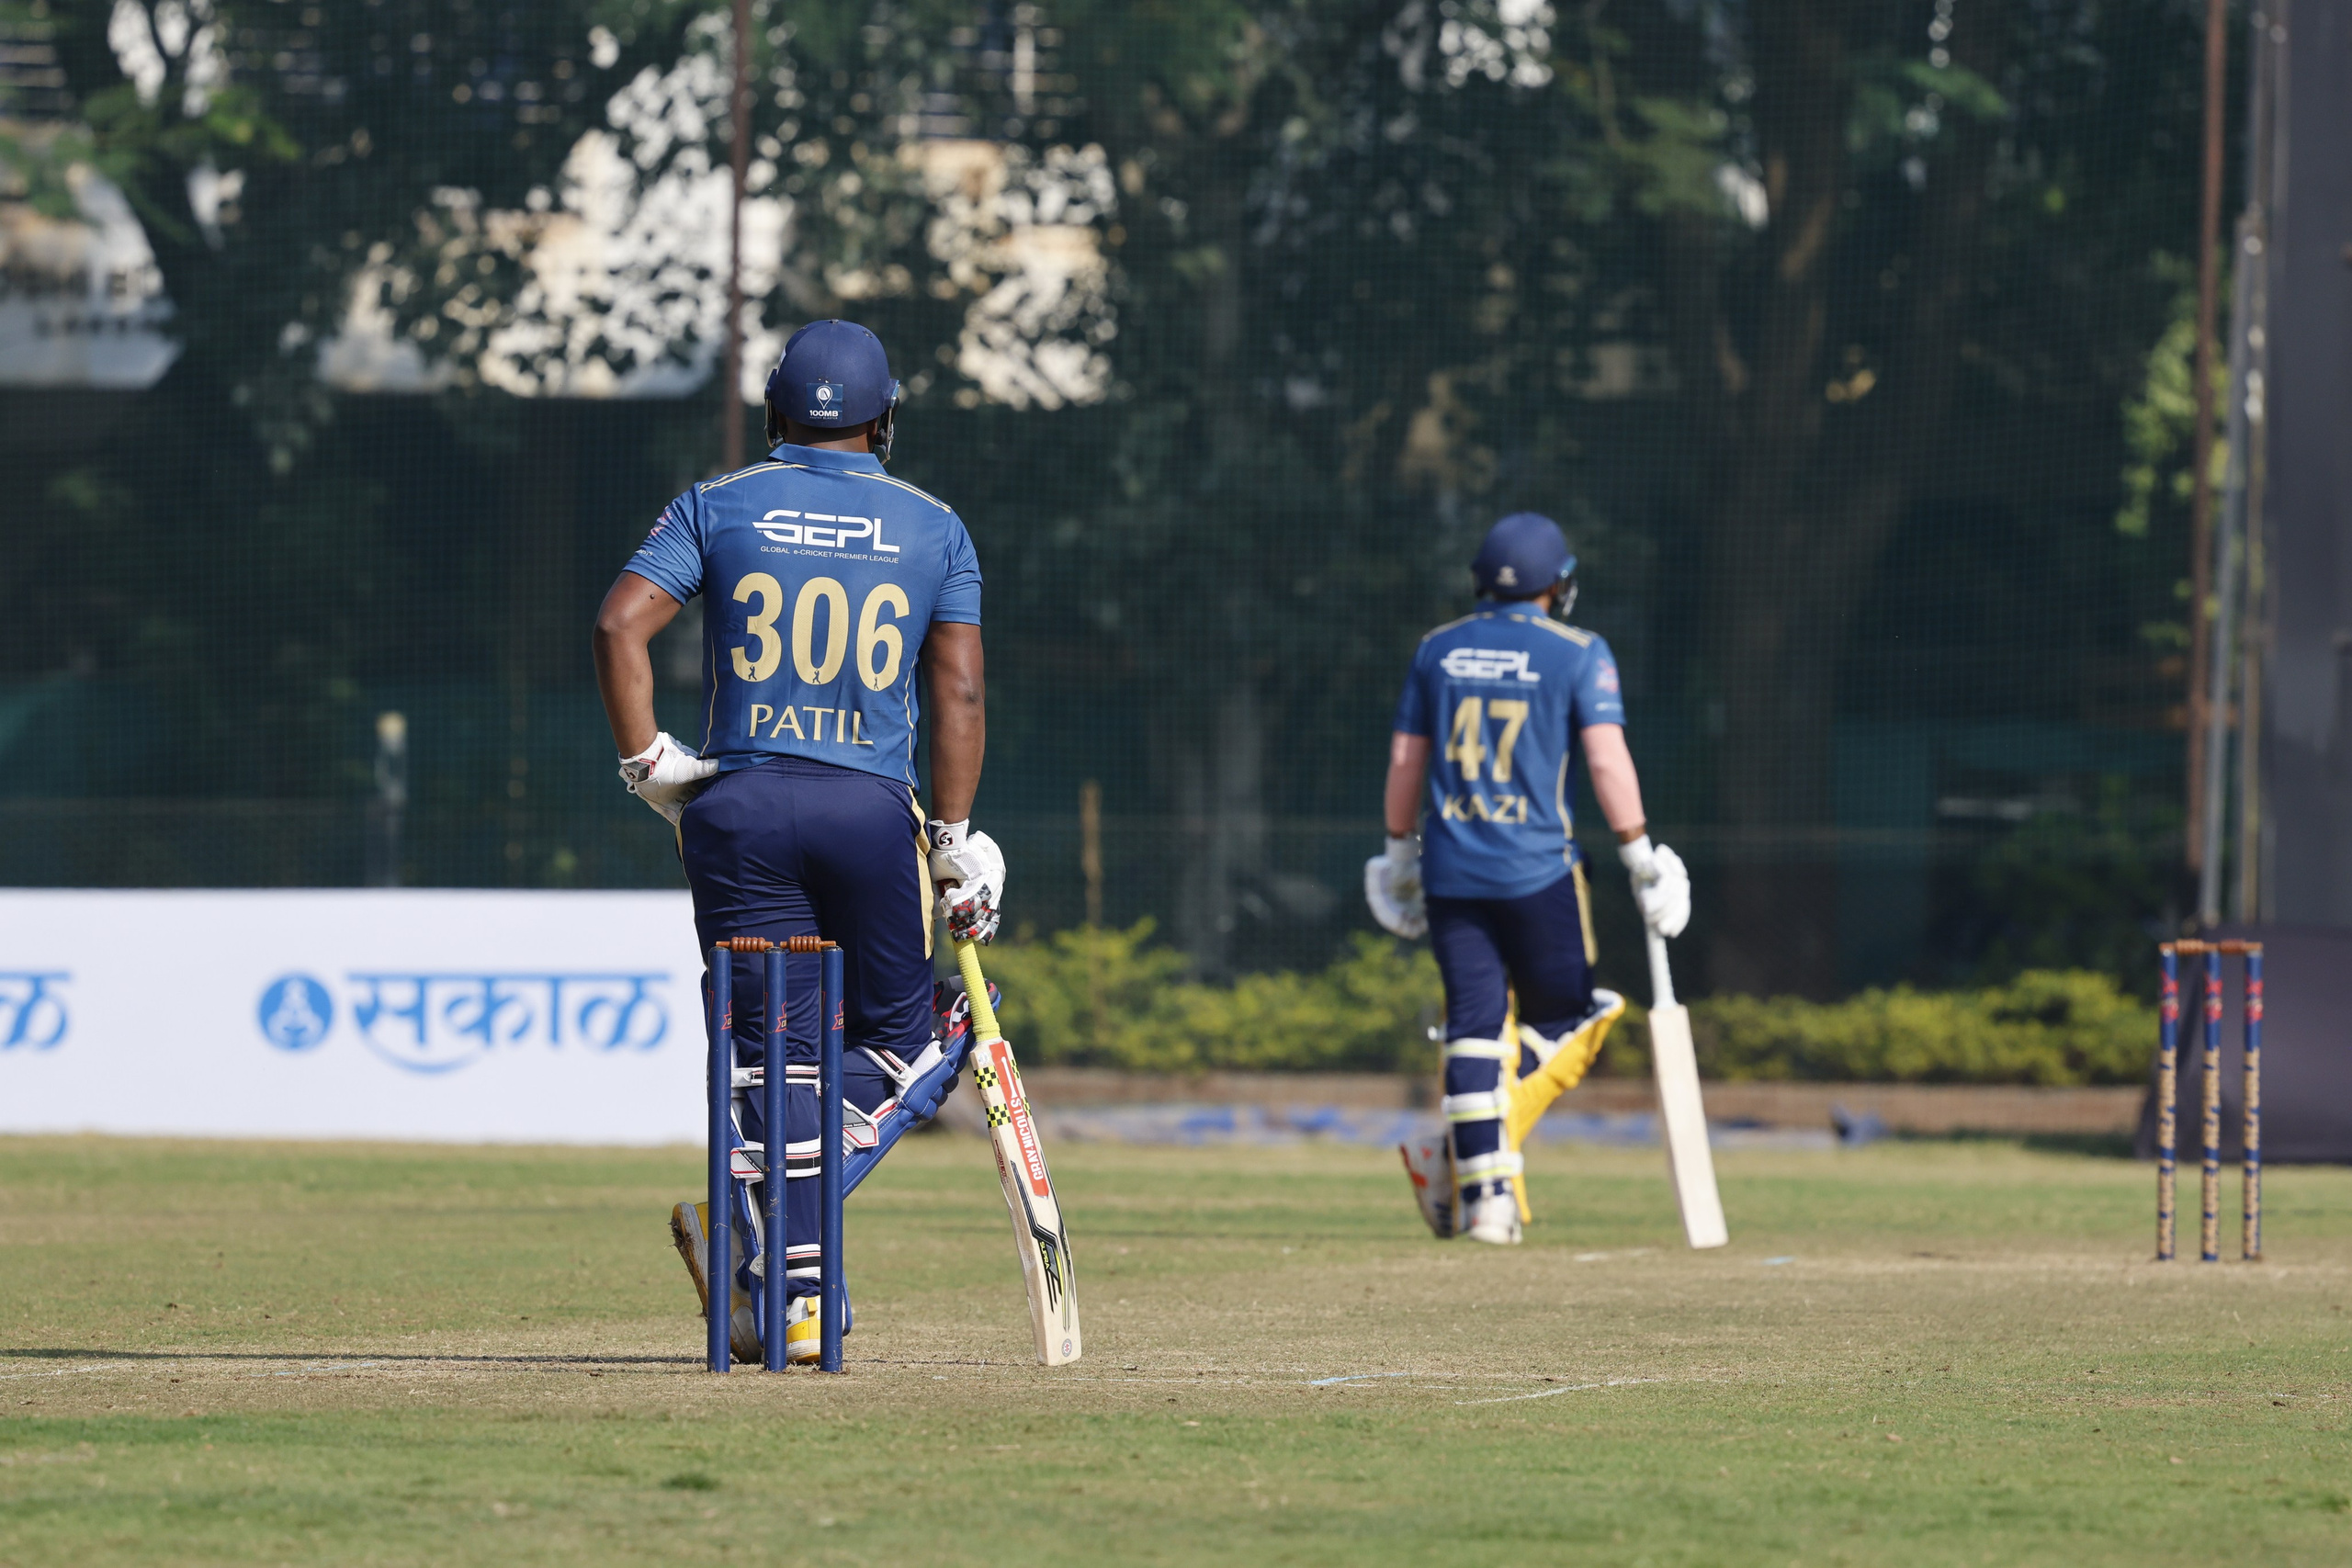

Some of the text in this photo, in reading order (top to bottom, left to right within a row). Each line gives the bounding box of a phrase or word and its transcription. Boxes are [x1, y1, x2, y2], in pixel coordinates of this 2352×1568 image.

[752, 510, 899, 553] GEPL
[761, 546, 790, 555] GLOBAL
[793, 549, 832, 558] e-CRICKET
[869, 555, 899, 564] LEAGUE
[730, 572, 910, 692] 306
[1440, 648, 1541, 682] GEPL
[750, 705, 874, 744] PATIL
[1445, 696, 1530, 783] 47
[1441, 793, 1528, 824] KAZI
[347, 971, 670, 1074] सकाळ
[1011, 1098, 1044, 1180] GRAY-NICOLLS
[1039, 1241, 1050, 1269] SUPRA
